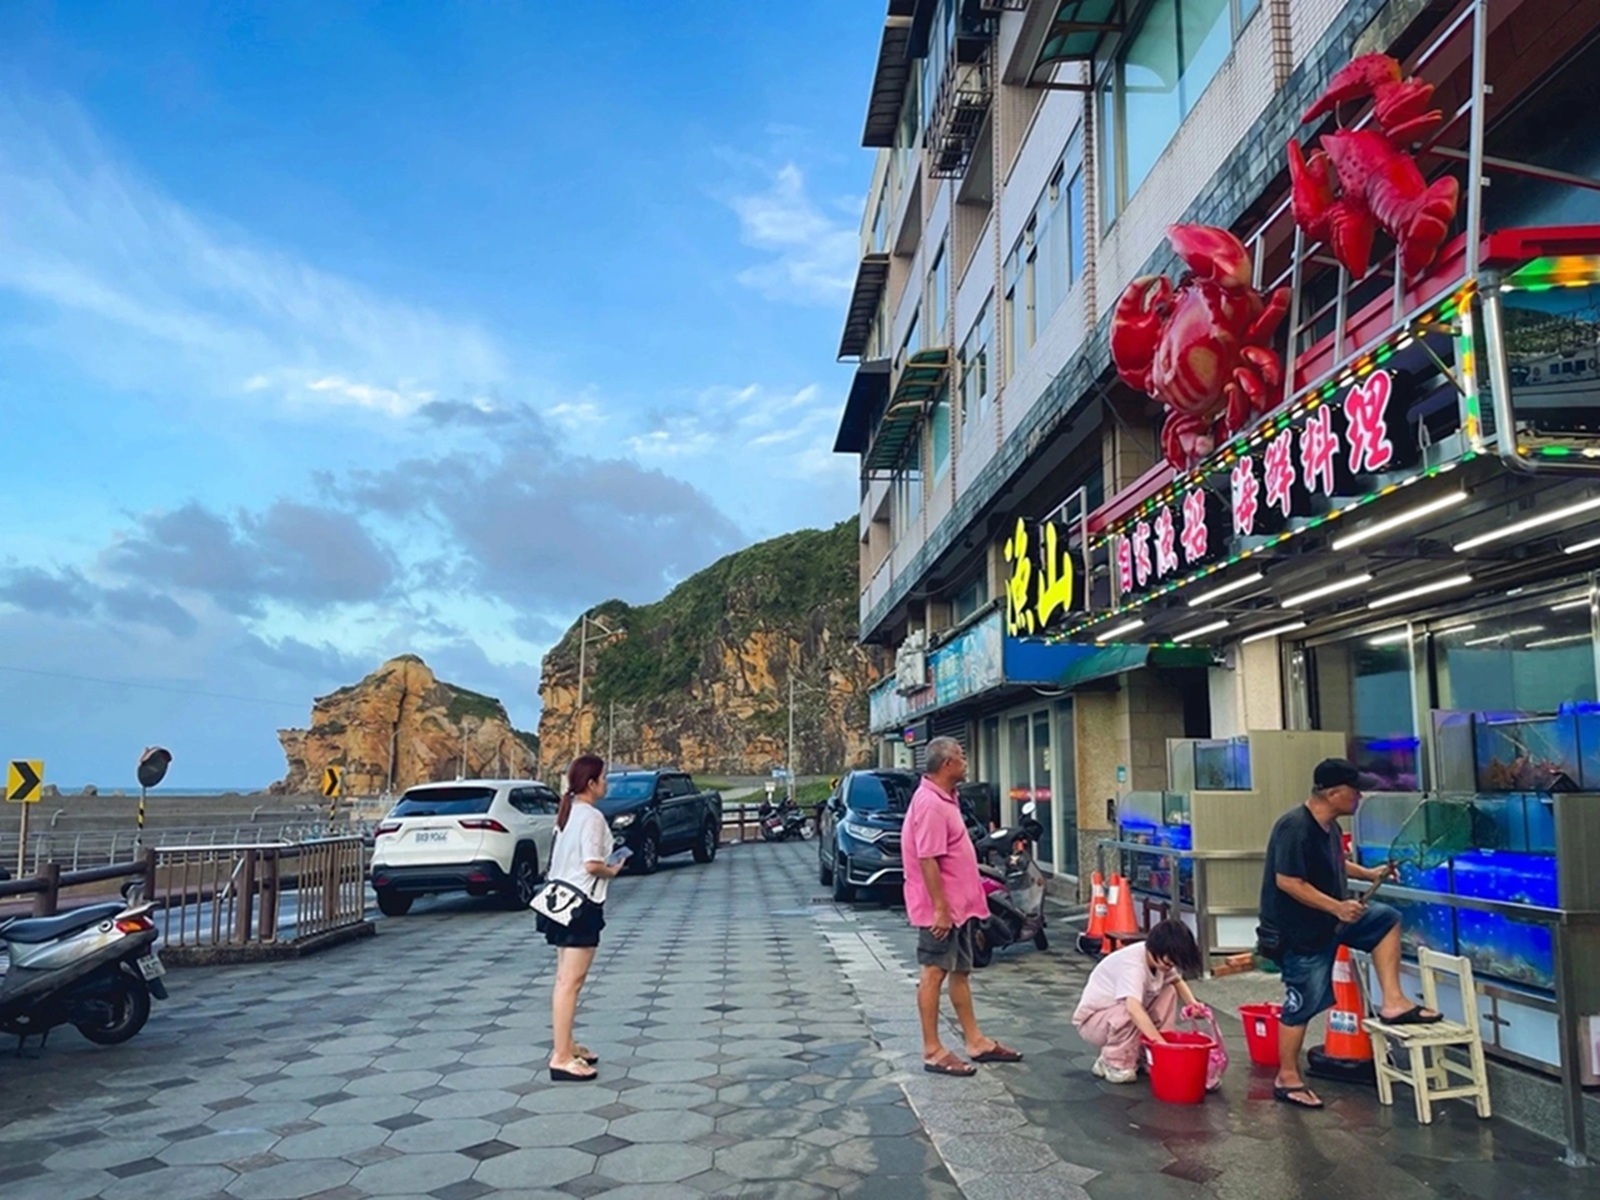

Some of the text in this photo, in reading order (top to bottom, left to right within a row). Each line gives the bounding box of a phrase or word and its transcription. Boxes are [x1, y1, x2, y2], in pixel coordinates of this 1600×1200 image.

[1231, 369, 1392, 535] 海鮮料理
[1004, 517, 1073, 637] 漁山
